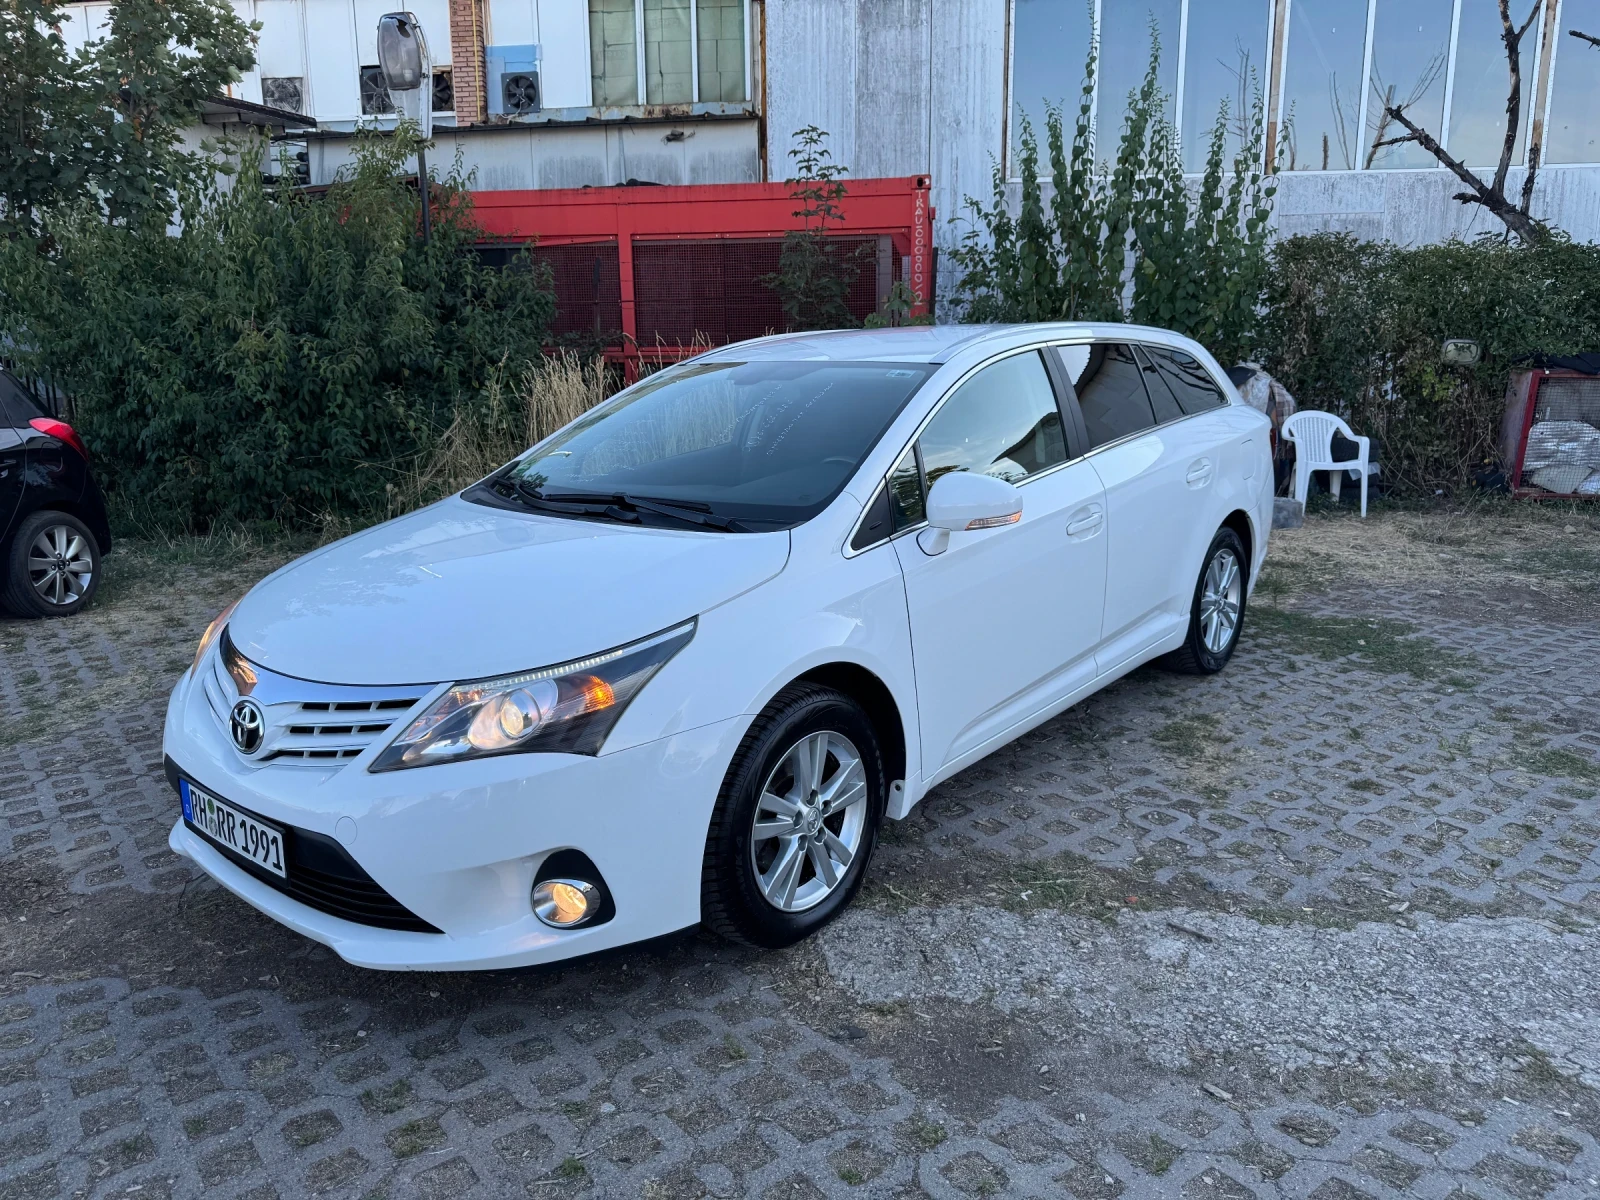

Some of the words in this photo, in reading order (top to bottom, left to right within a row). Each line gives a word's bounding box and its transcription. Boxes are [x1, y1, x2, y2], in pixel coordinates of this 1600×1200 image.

[190, 789, 208, 830] RH
[216, 805, 237, 846] RR
[240, 819, 283, 870] 1991
